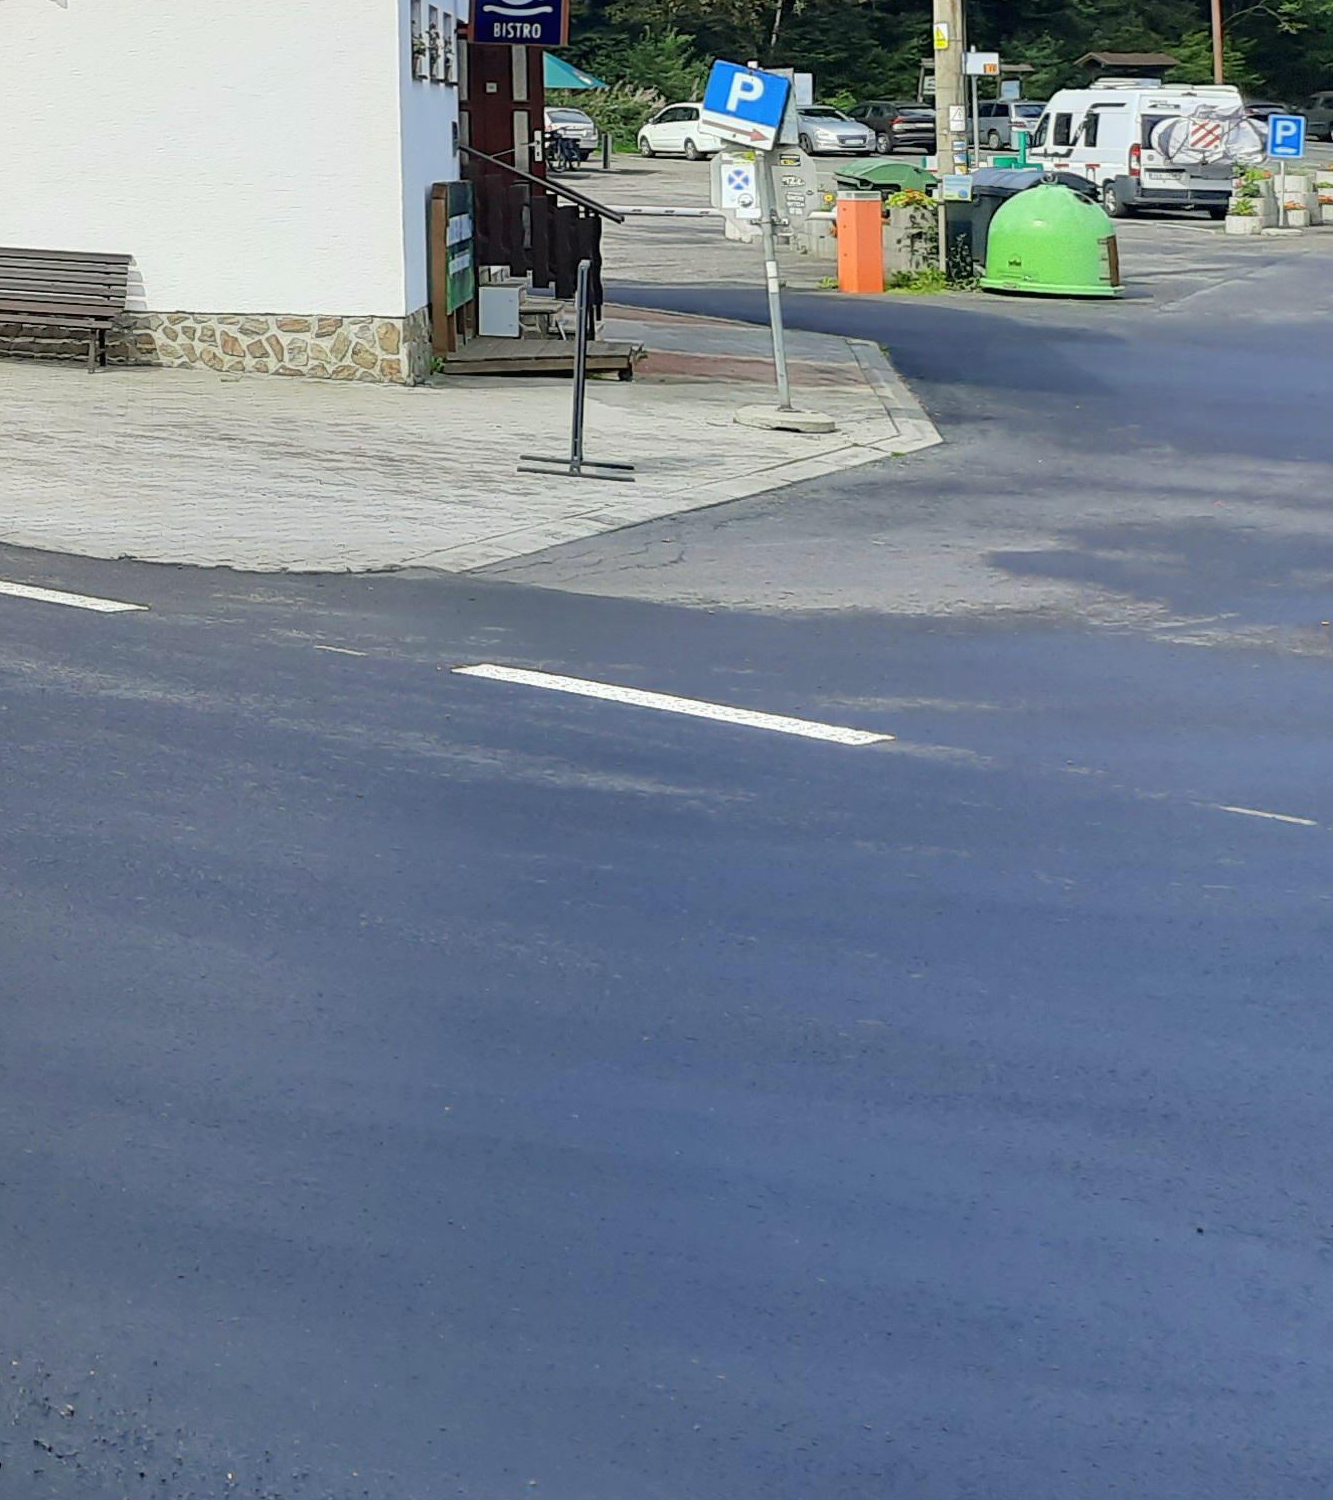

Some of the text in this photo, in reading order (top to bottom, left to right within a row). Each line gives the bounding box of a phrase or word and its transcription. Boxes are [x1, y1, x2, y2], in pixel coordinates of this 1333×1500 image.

[493, 22, 542, 39] BISTRO
[725, 71, 765, 112] P
[1275, 120, 1297, 145] P
